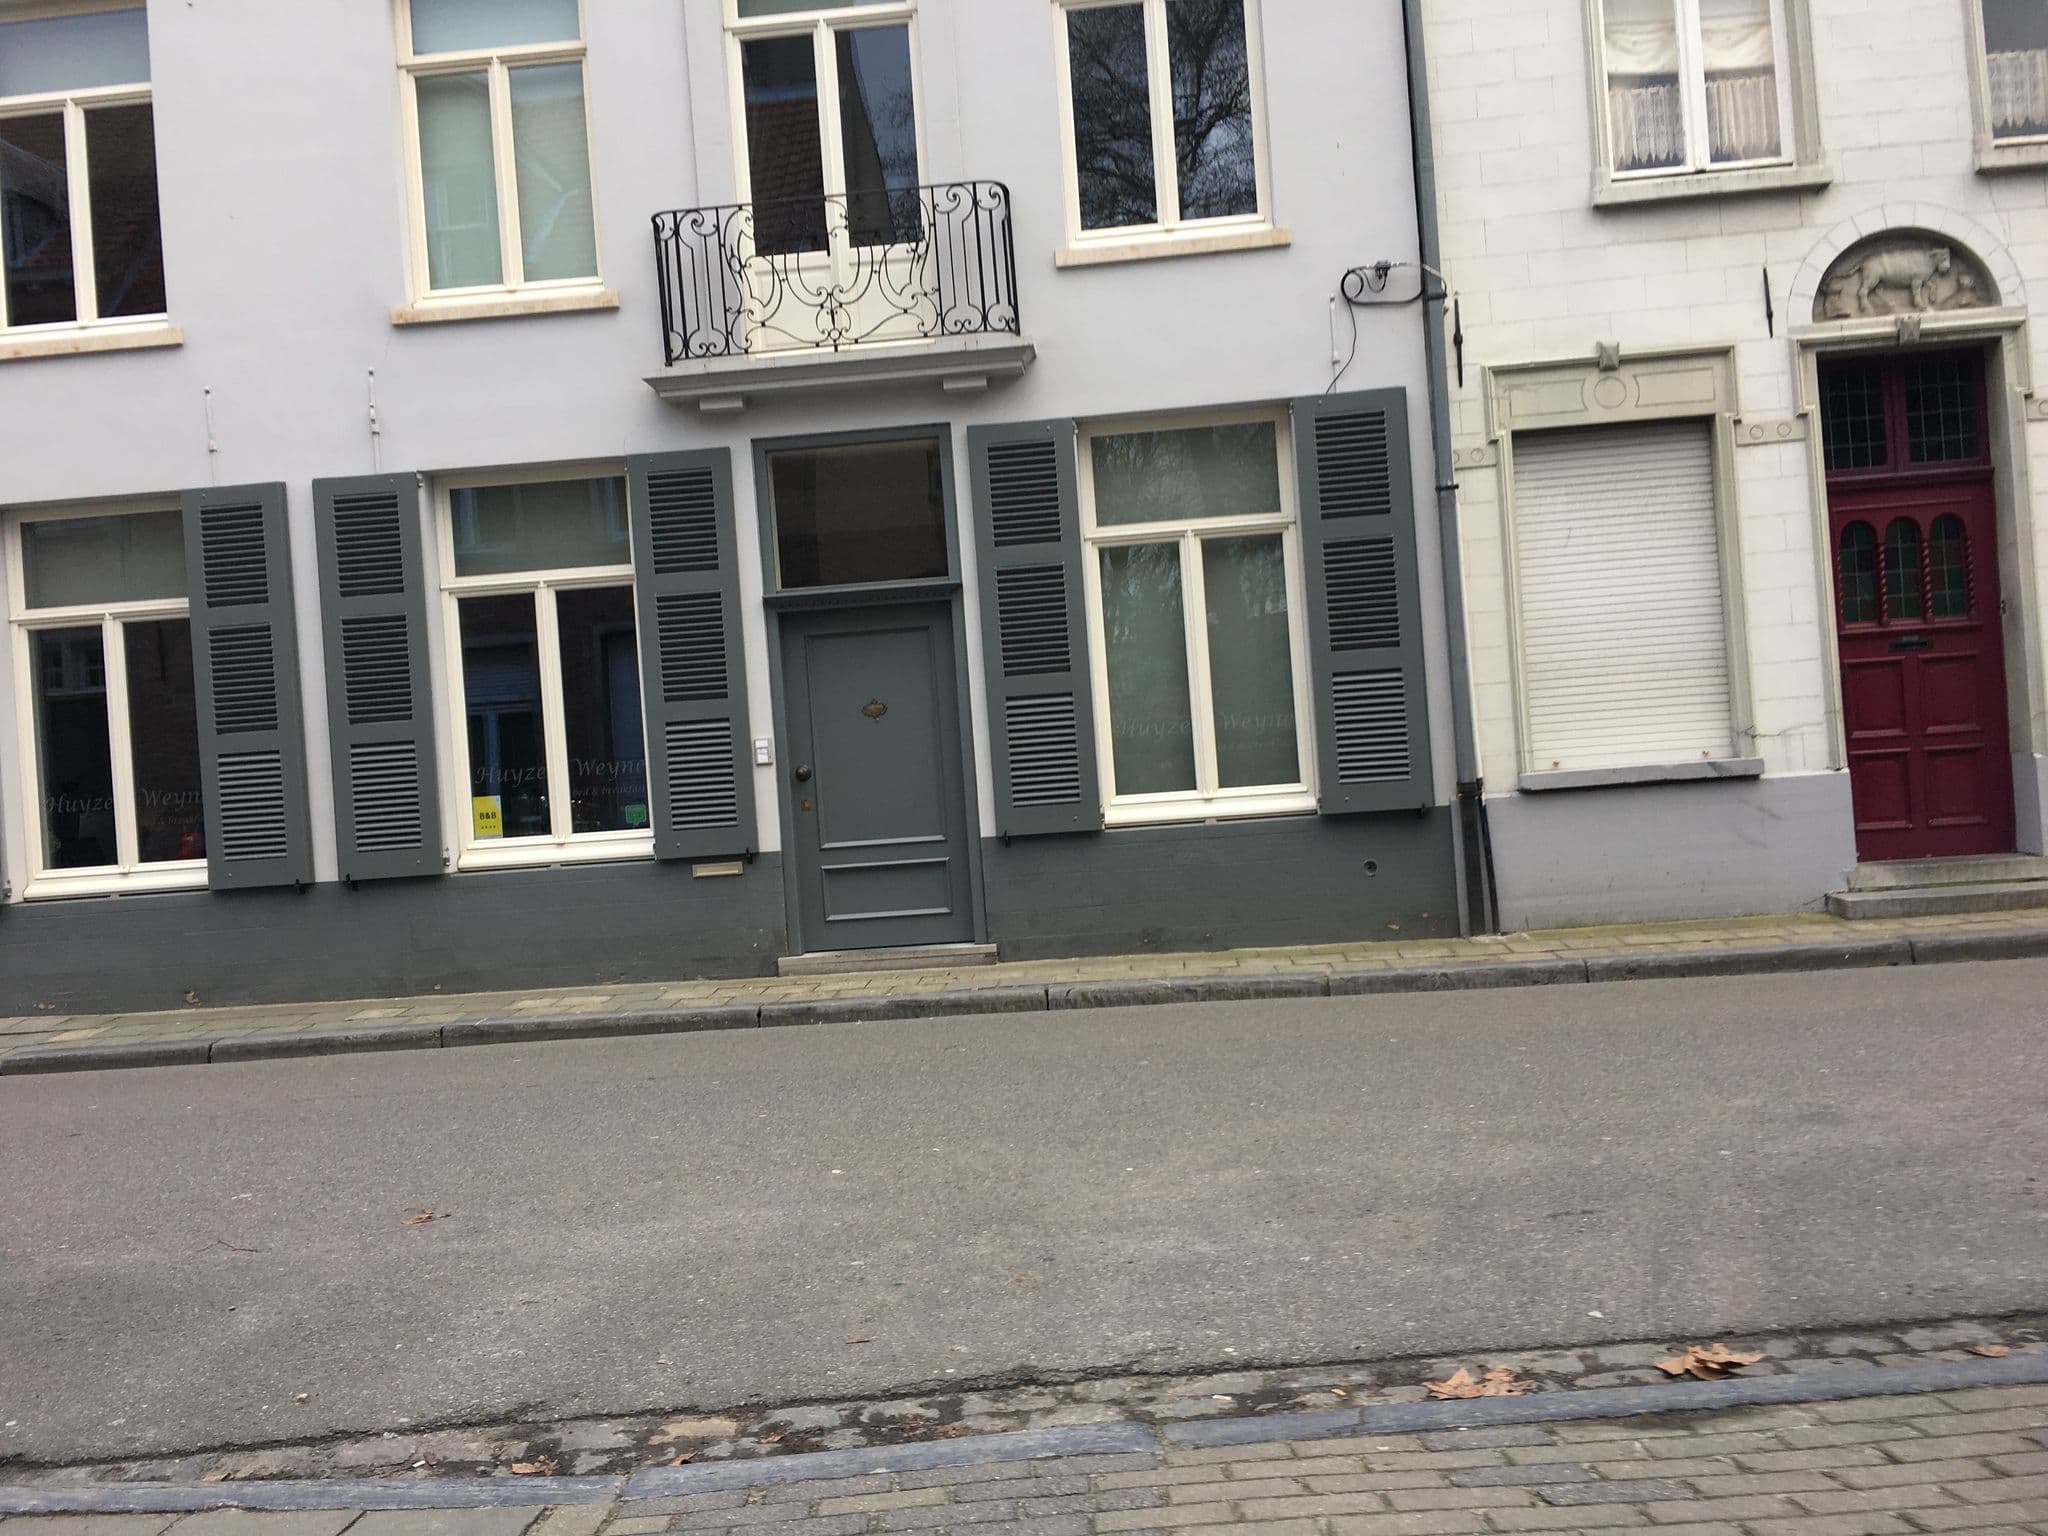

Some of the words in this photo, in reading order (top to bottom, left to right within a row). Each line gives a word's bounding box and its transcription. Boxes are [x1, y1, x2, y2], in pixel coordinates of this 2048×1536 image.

[474, 767, 545, 789] Huyze
[45, 793, 113, 818] Huyze
[138, 787, 201, 812] Weyn
[479, 811, 497, 820] B&B
